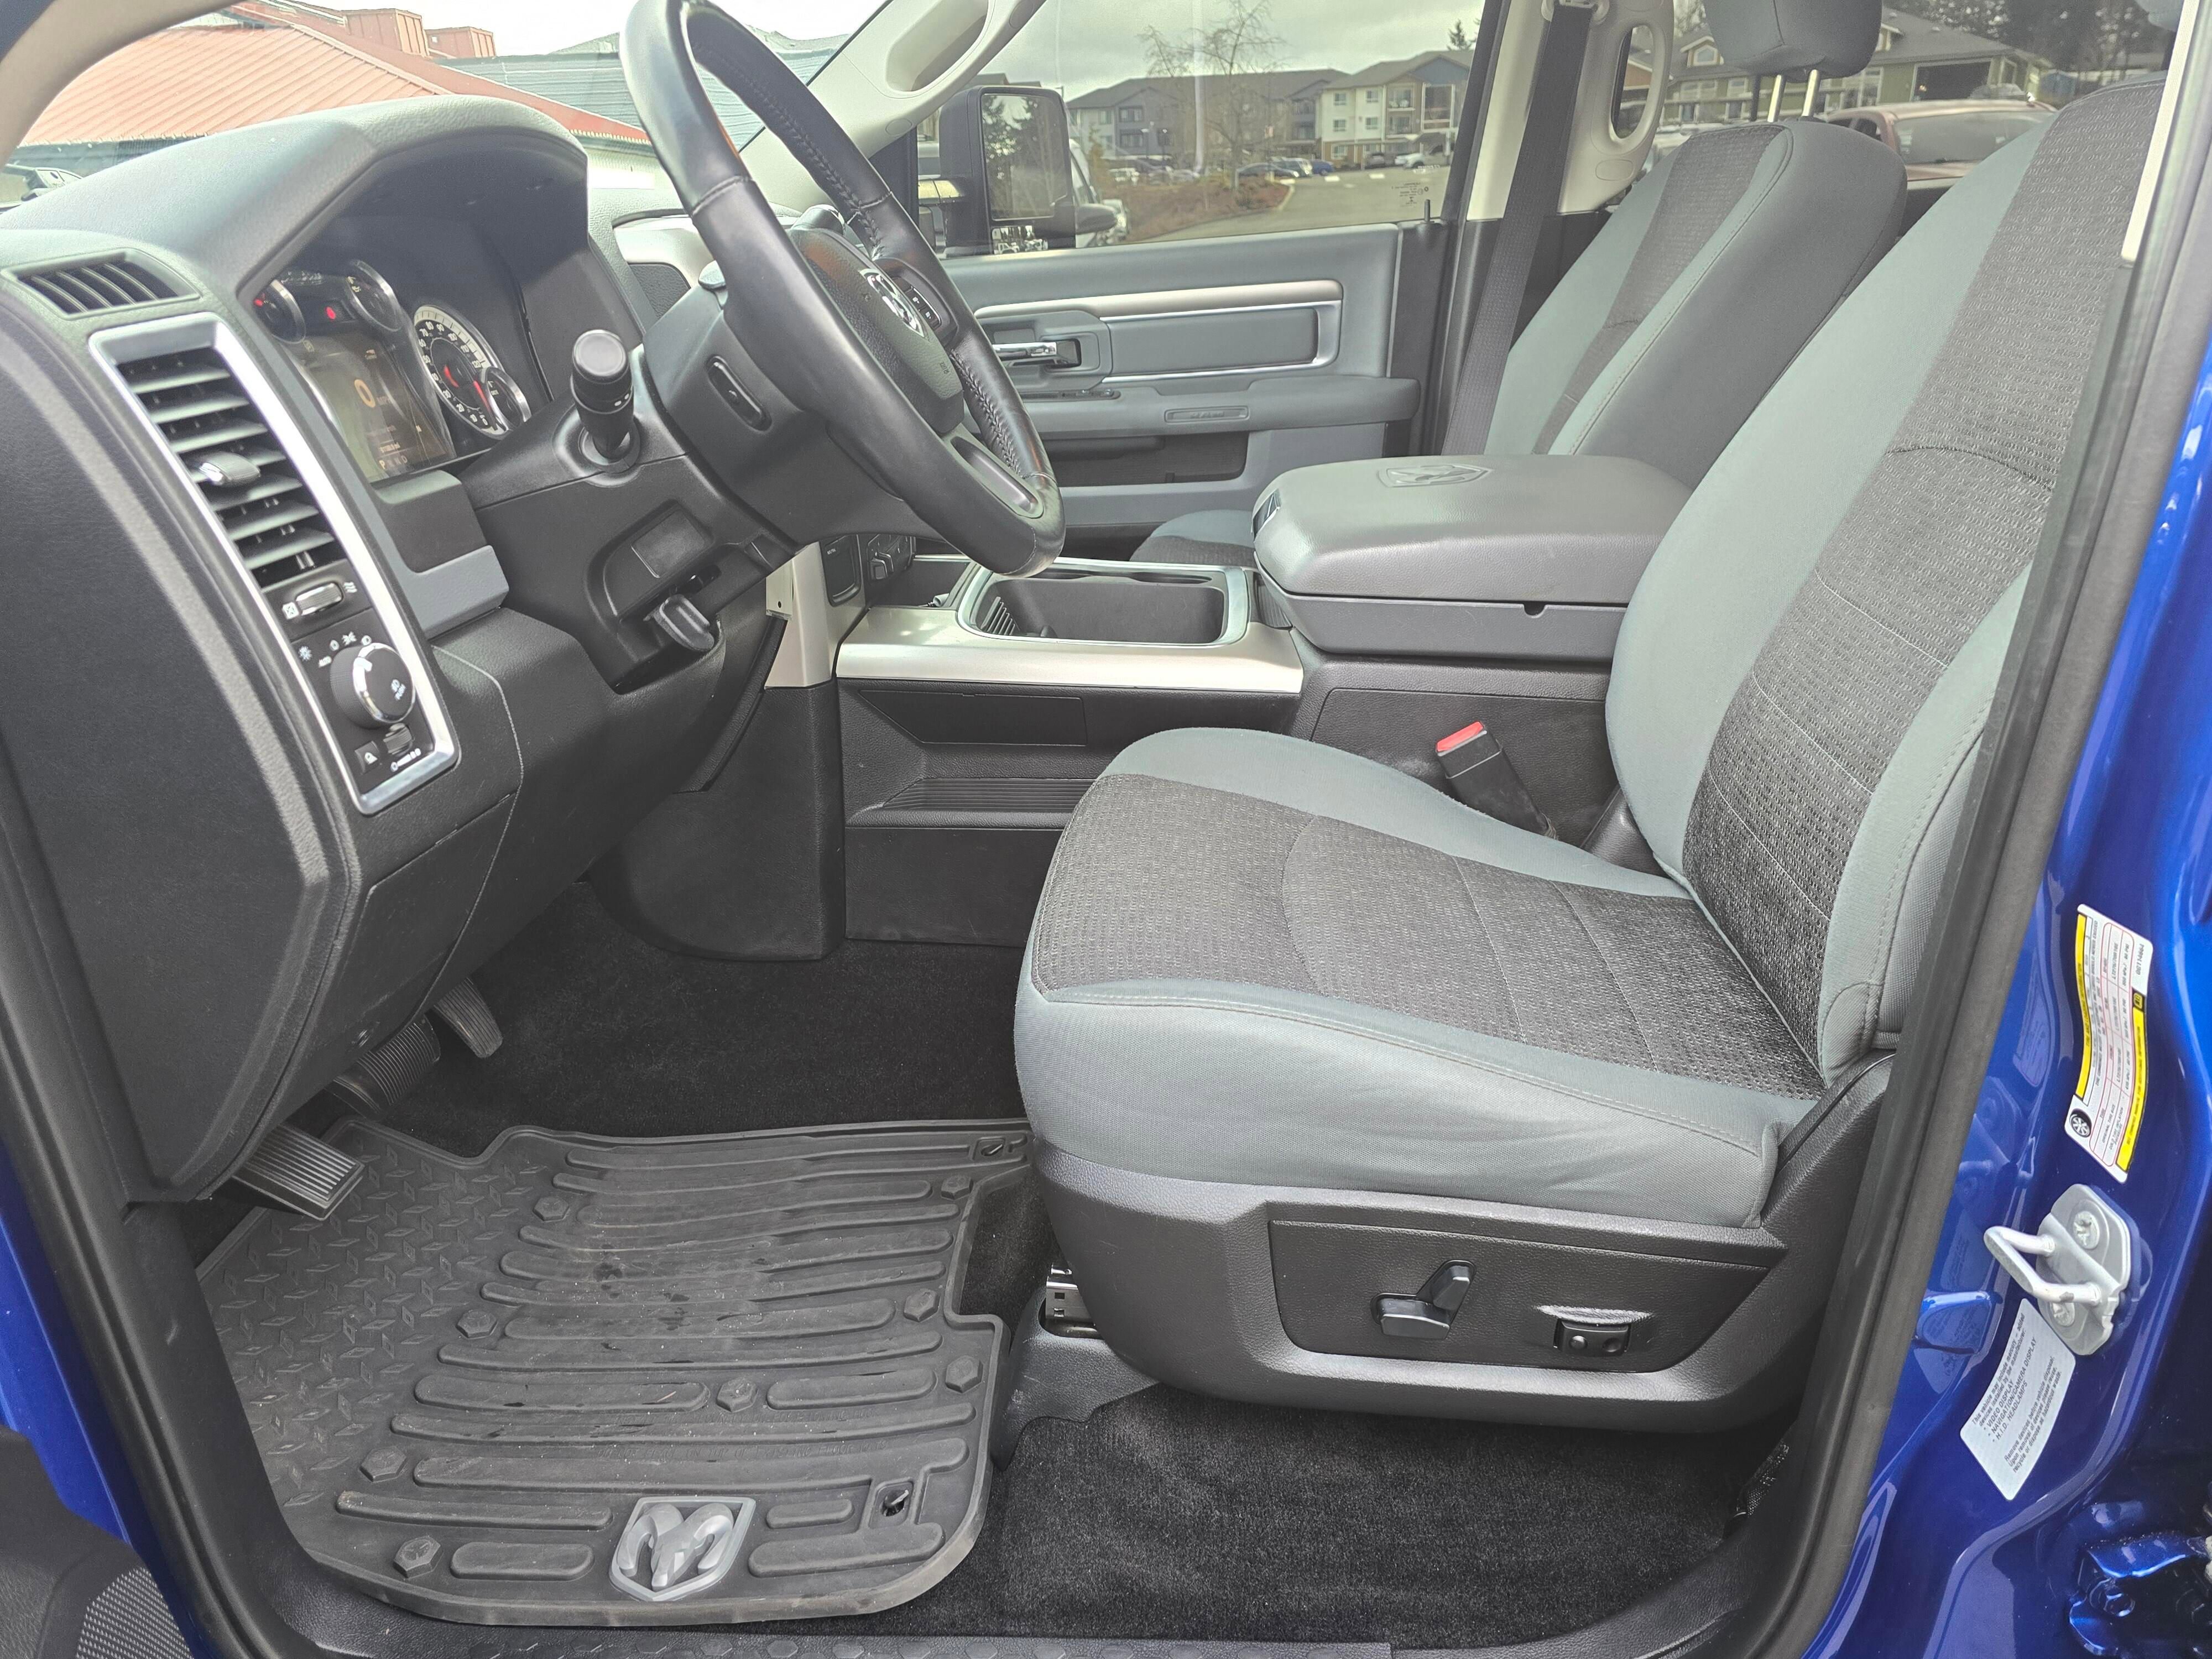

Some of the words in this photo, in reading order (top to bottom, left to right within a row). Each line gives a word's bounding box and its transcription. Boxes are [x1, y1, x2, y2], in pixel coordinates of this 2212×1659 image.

[1971, 1412, 1981, 1425] This
[1980, 1394, 1992, 1413] vehicle
[1991, 1381, 1999, 1394] may
[1996, 1361, 2008, 1382] include
[2006, 1339, 2017, 1362] mercury
[2015, 1312, 2025, 1332] added
[1979, 1406, 1992, 1427] devices
[1990, 1383, 2005, 1407] installed
[2001, 1375, 2008, 1384] by
[1986, 1407, 2000, 1427] VIDEO
[1998, 1378, 2013, 1408] DISPLAY
[1990, 1366, 2026, 1433] NAVIGATION/CAMERA
[2023, 1335, 2036, 1367] DISPLAY
[1995, 1422, 2009, 1440] H.I.D.
[2006, 1380, 2028, 1421] HEADLAMPS
[2004, 1439, 2020, 1461] Remove
[2018, 1419, 2031, 1441] devices
[2027, 1401, 2038, 1419] before
[2036, 1380, 2046, 1401] vehicle
[2042, 1355, 2054, 1381] disposal.
[2008, 1452, 2020, 1467] Upon
[2017, 1430, 2032, 1453] removal
[2033, 1402, 2044, 1425] devices
[2041, 1384, 2050, 1404] please
[2047, 1366, 2058, 1384] reuse,
[2012, 1453, 2026, 1473] recycle
[2025, 1445, 2030, 1453] or
[2028, 1425, 2041, 1447] dispose
[2039, 1416, 2044, 1425] as
[2042, 1388, 2055, 1417] hazardous
[2052, 1371, 2062, 1389] waste.
